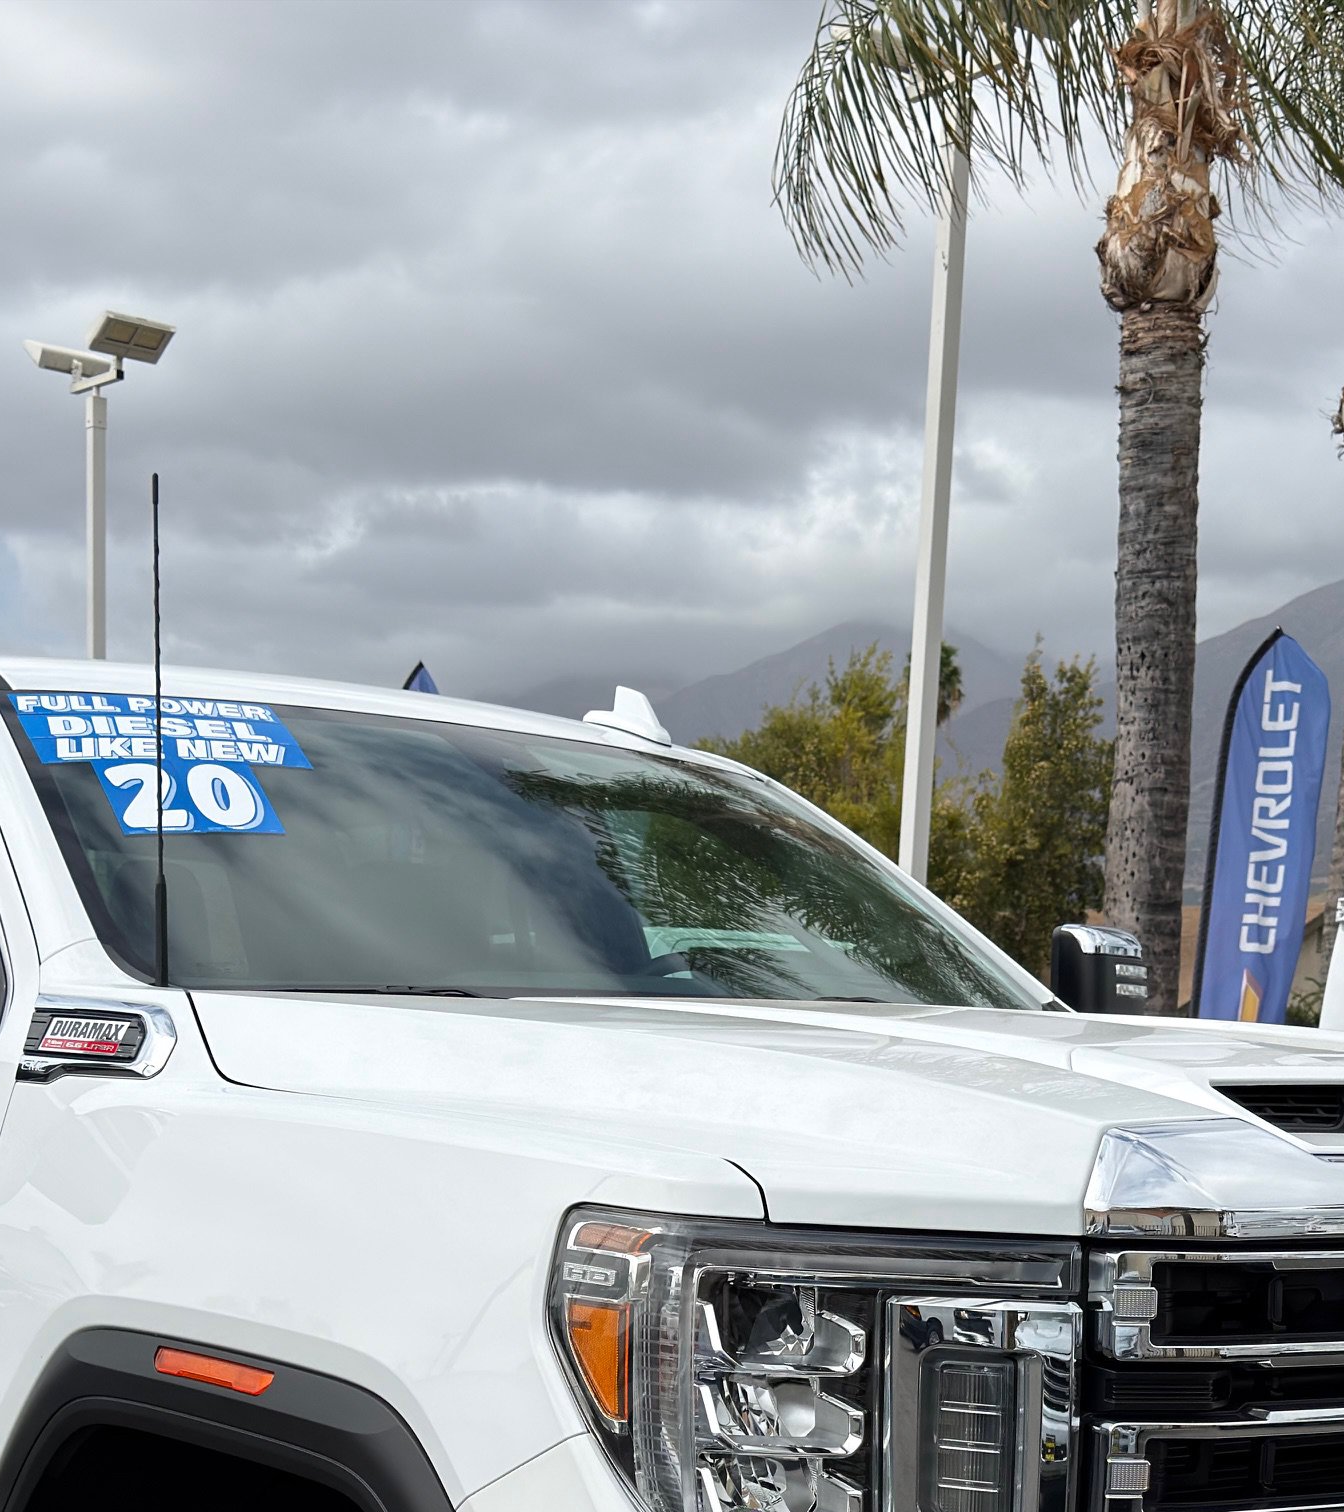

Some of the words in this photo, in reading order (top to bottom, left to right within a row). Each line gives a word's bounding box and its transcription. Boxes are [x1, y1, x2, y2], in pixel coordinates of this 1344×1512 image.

[16, 695, 120, 713] FULL
[127, 697, 276, 722] POWER
[46, 716, 272, 742] DIESEL
[56, 737, 164, 760] LIKE
[176, 739, 286, 764] NEW
[104, 763, 265, 831] 20
[1239, 669, 1303, 954] CHEVROLET
[50, 1020, 125, 1042] DURAMAX
